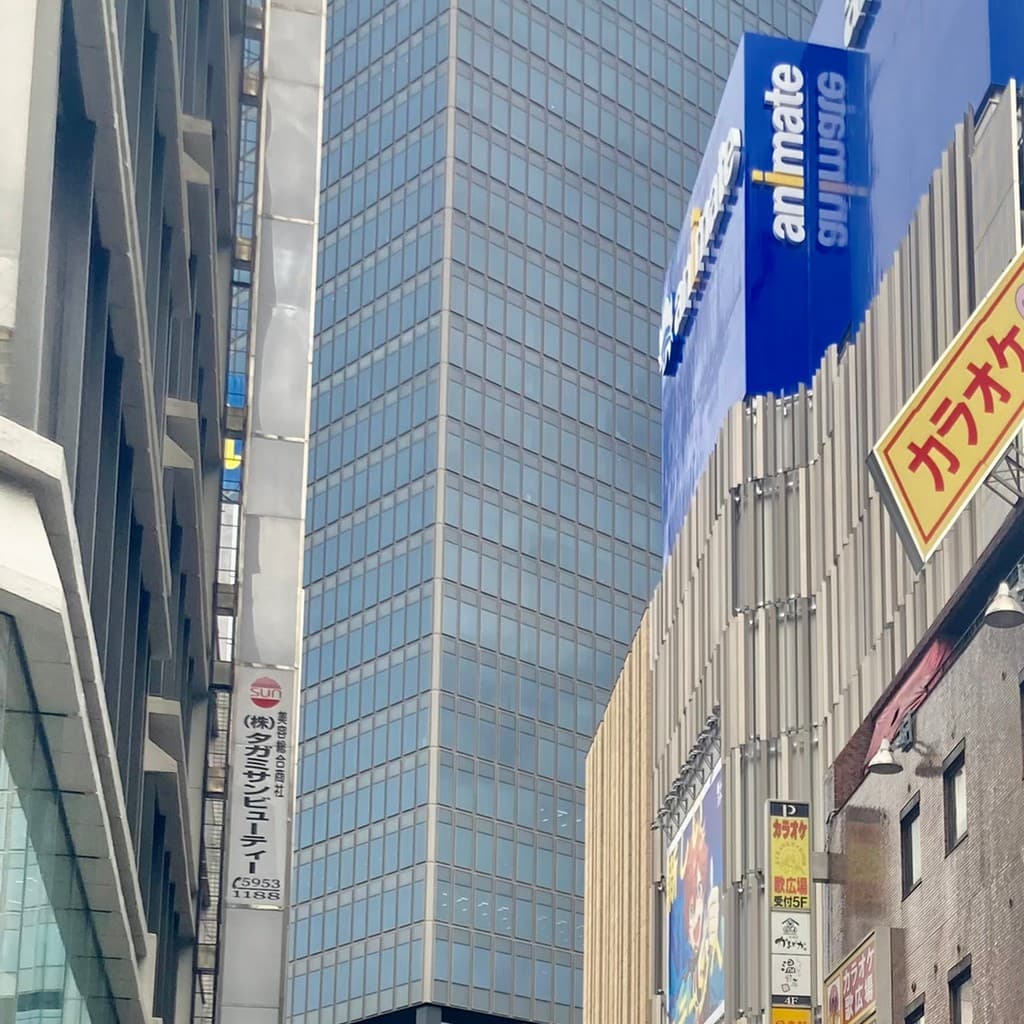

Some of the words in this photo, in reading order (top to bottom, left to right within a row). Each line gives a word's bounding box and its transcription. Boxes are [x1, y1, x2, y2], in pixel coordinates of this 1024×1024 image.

[752, 63, 806, 244] animate
[250, 687, 282, 699] sun
[773, 819, 808, 840] カラオケ
[241, 876, 281, 889] 5953
[774, 875, 808, 896] 歌広場
[233, 889, 281, 901] 1188
[773, 896, 808, 909] 受付5F
[843, 946, 875, 993] カラオケ
[844, 974, 874, 1021] 歌広場
